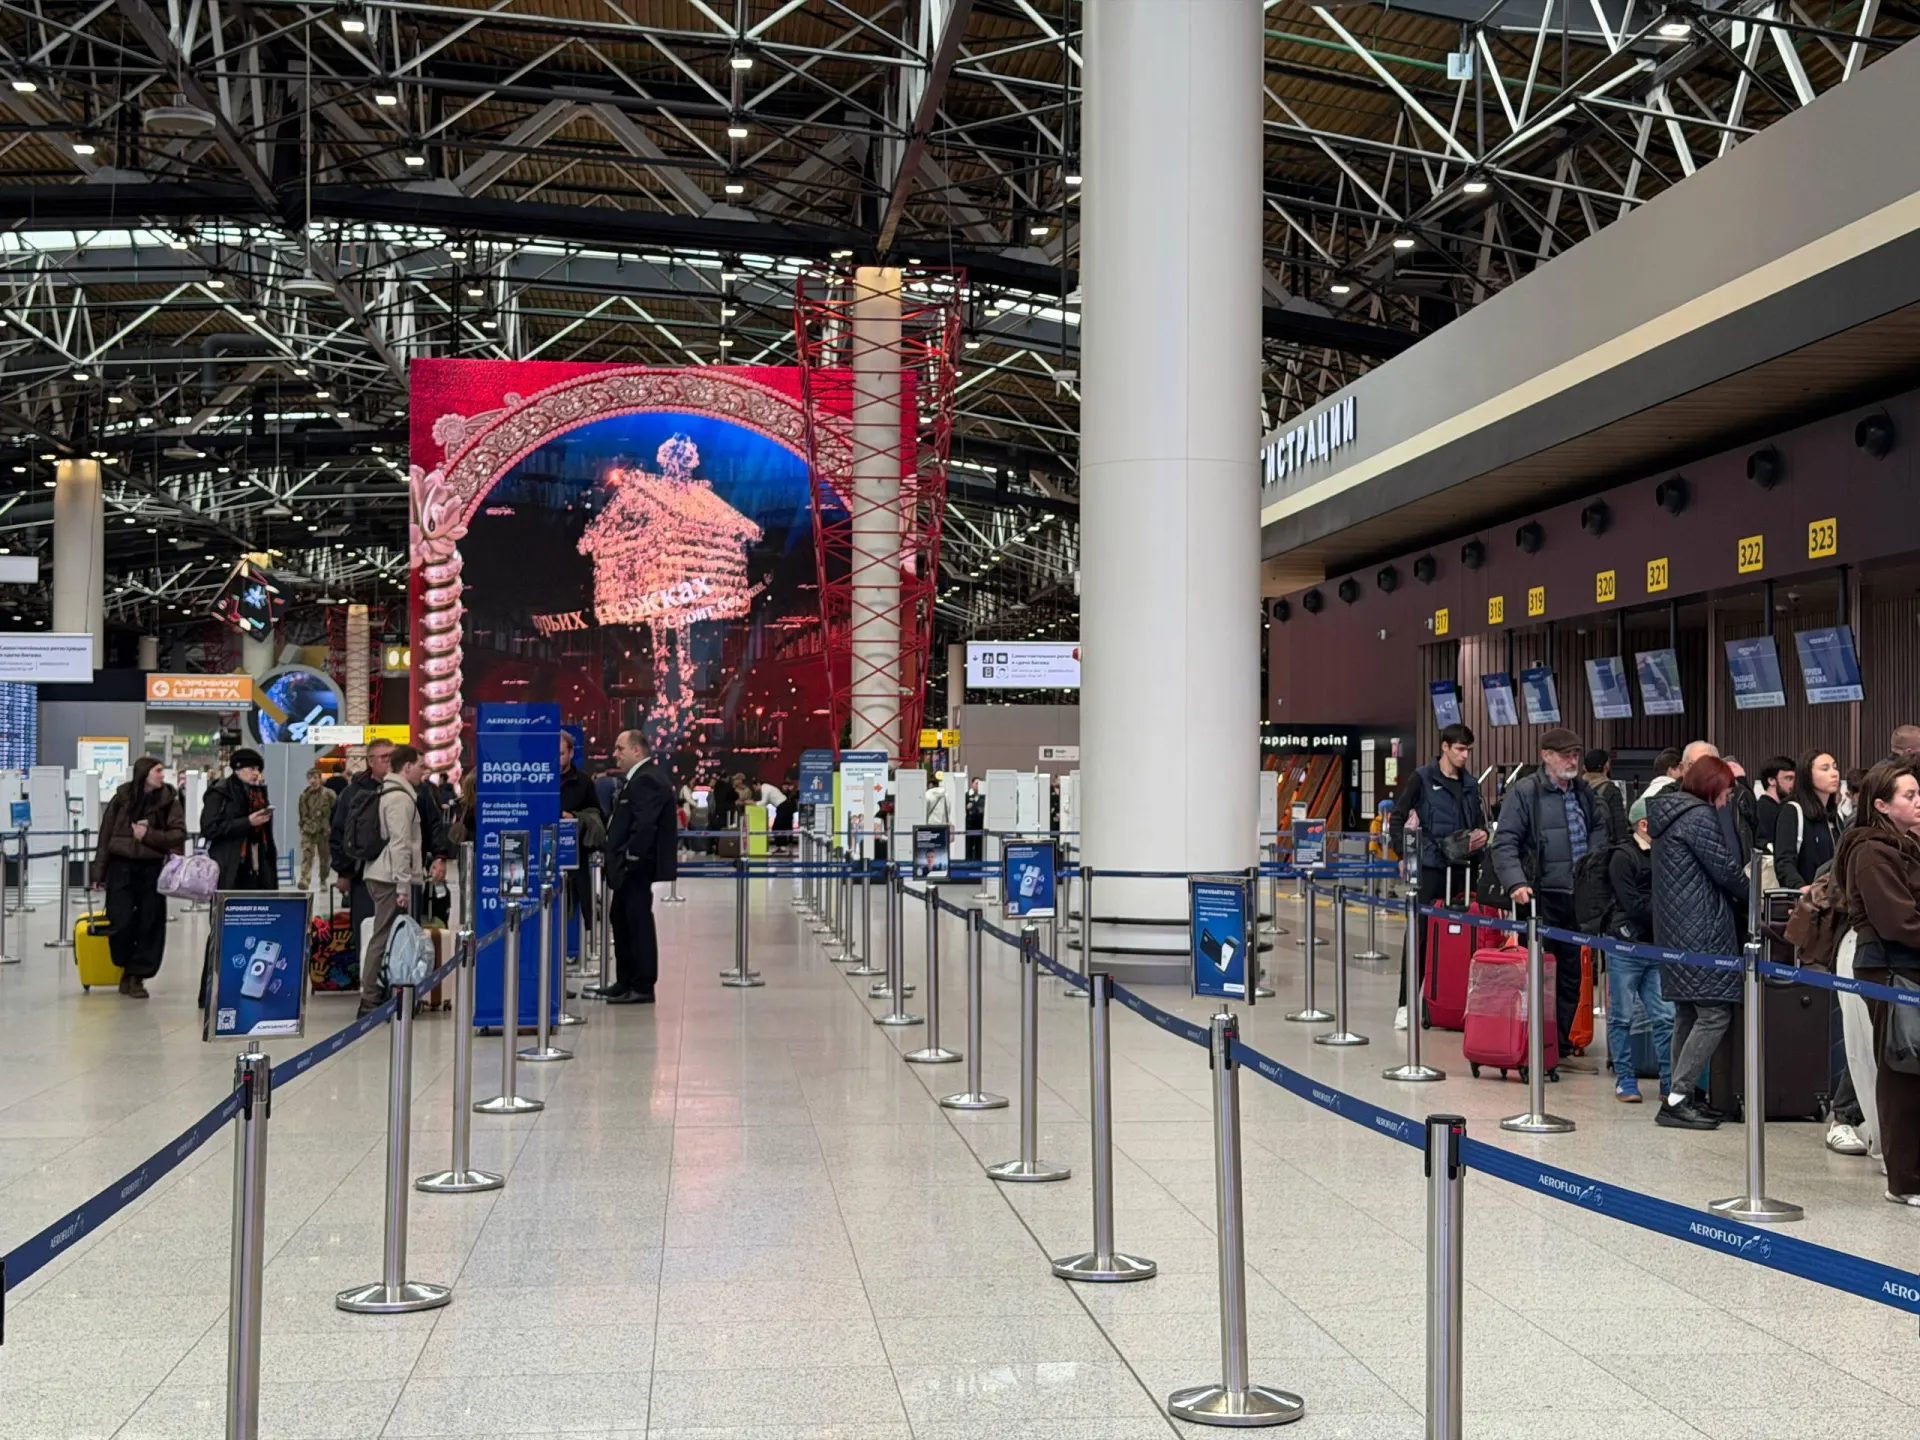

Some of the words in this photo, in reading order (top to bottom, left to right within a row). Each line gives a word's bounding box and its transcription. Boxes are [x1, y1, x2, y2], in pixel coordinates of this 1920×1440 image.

[1811, 525, 1834, 552] 323
[1741, 542, 1760, 567] 322
[1650, 564, 1666, 586] 321
[1598, 576, 1614, 597] 320
[1530, 591, 1543, 611] 319
[1490, 601, 1502, 620] 318
[1437, 613, 1447, 630] 317
[486, 717, 531, 725] AEROFLOT
[1313, 734, 1348, 747] point
[482, 762, 551, 773] BAGGAGE
[482, 773, 555, 784] DROP-OFF
[482, 809, 511, 817] Economy
[482, 865, 499, 877] 23
[482, 898, 497, 909] 10
[1375, 1115, 1399, 1132] AEROFLOT
[1538, 1173, 1582, 1197] AEROFLOT
[51, 1224, 75, 1249] AEROFLOT
[1689, 1221, 1744, 1248] AEROFLOT
